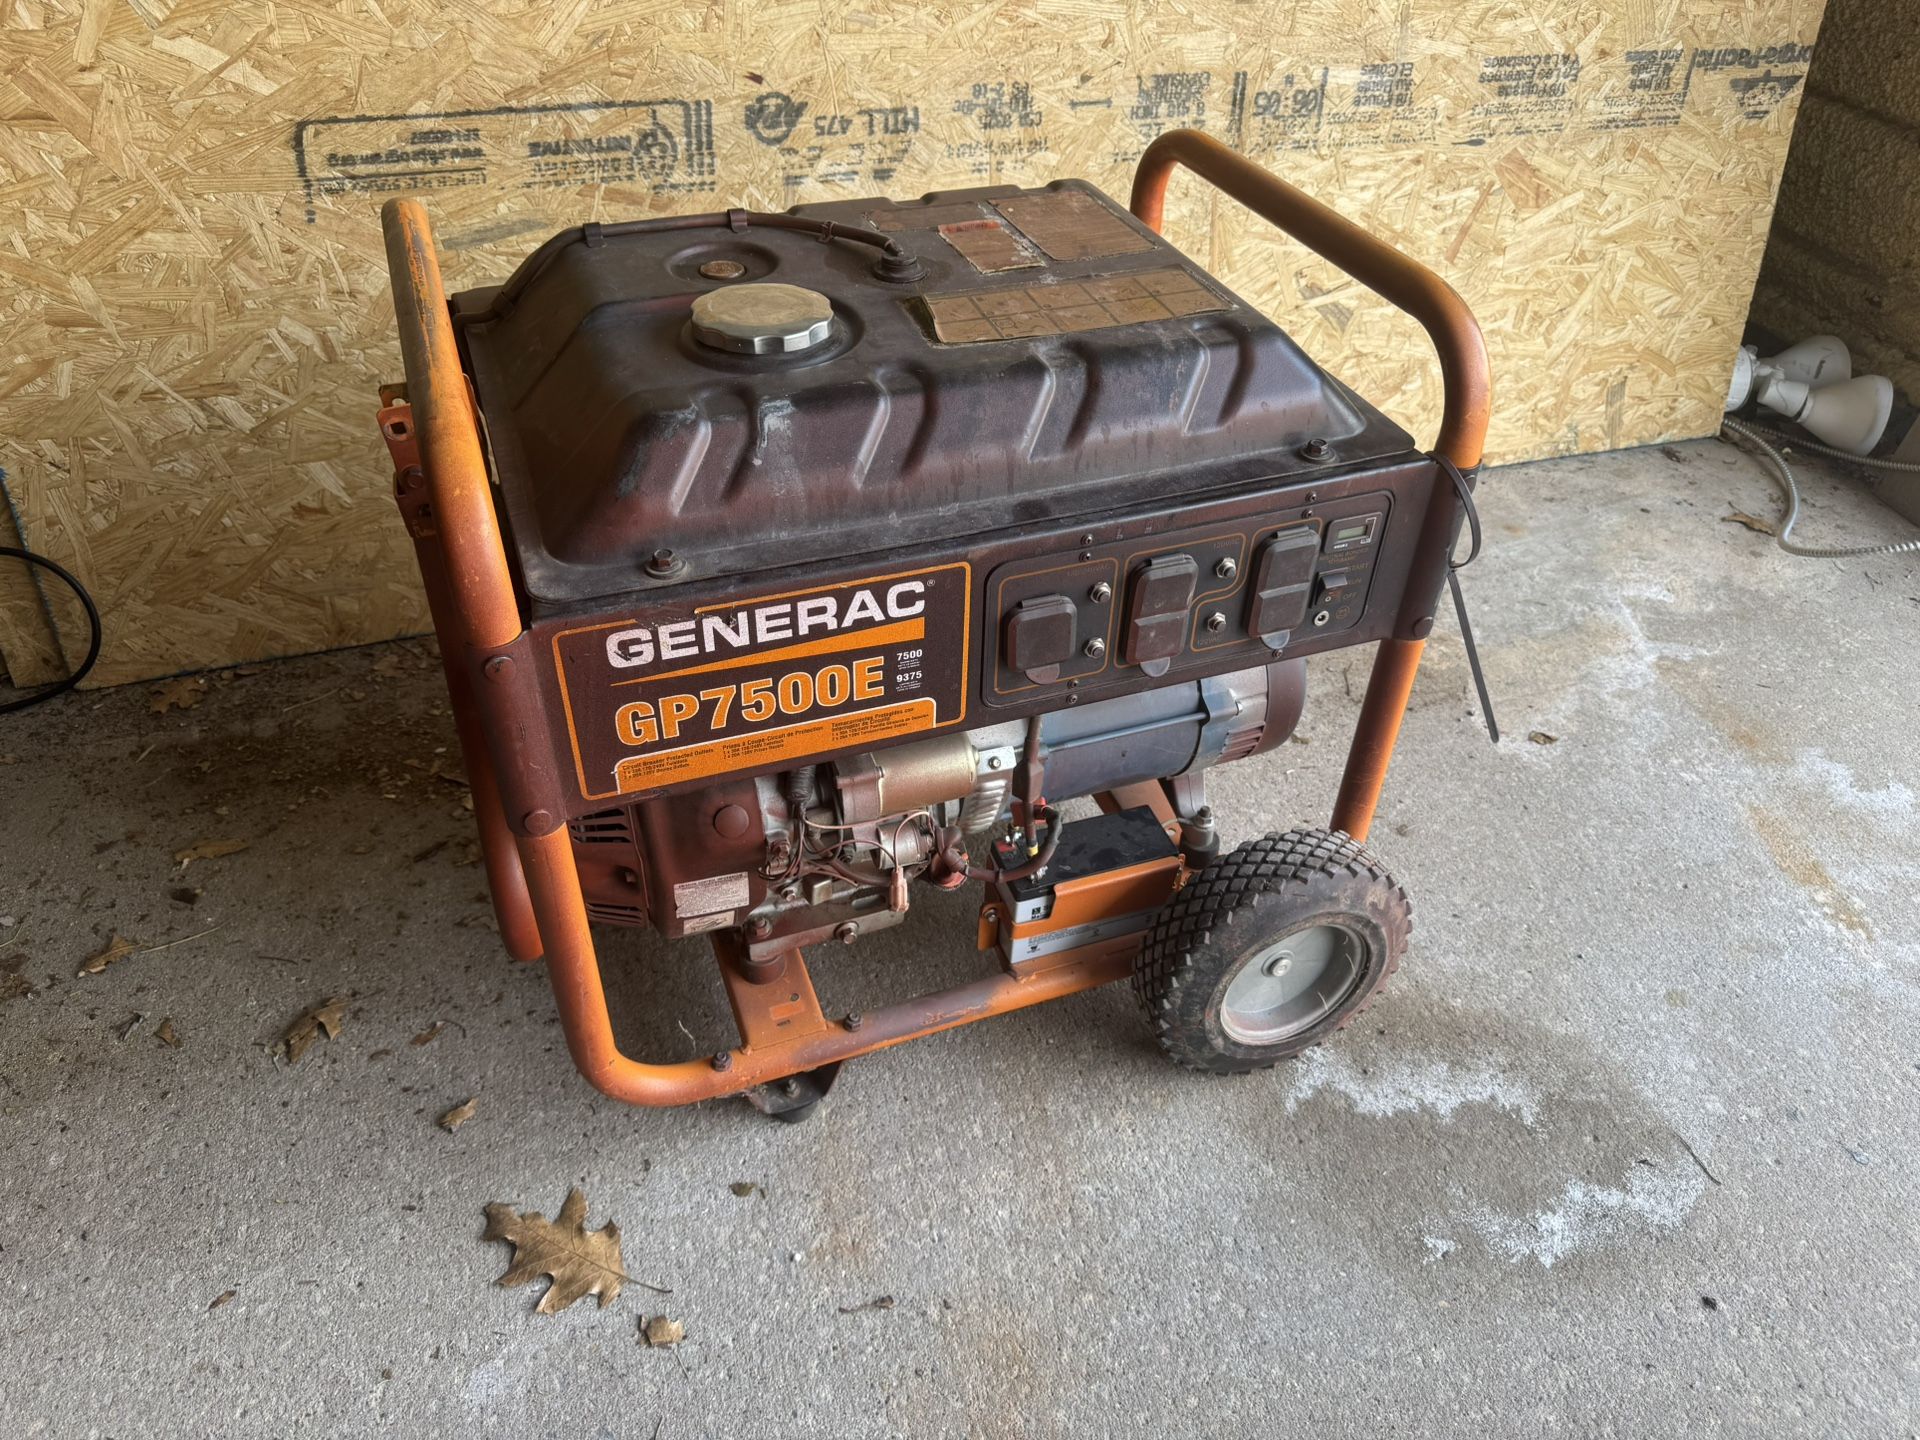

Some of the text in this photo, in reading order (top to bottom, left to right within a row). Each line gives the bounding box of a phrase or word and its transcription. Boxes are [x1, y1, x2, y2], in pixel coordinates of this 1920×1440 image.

[813, 105, 920, 137] MILL 475
[606, 581, 925, 669] GENERAC
[896, 649, 923, 662] 7500
[896, 671, 922, 683] 9375
[615, 656, 884, 746] GP7500E
[795, 725, 823, 735] Protection
[666, 752, 693, 762] Protected
